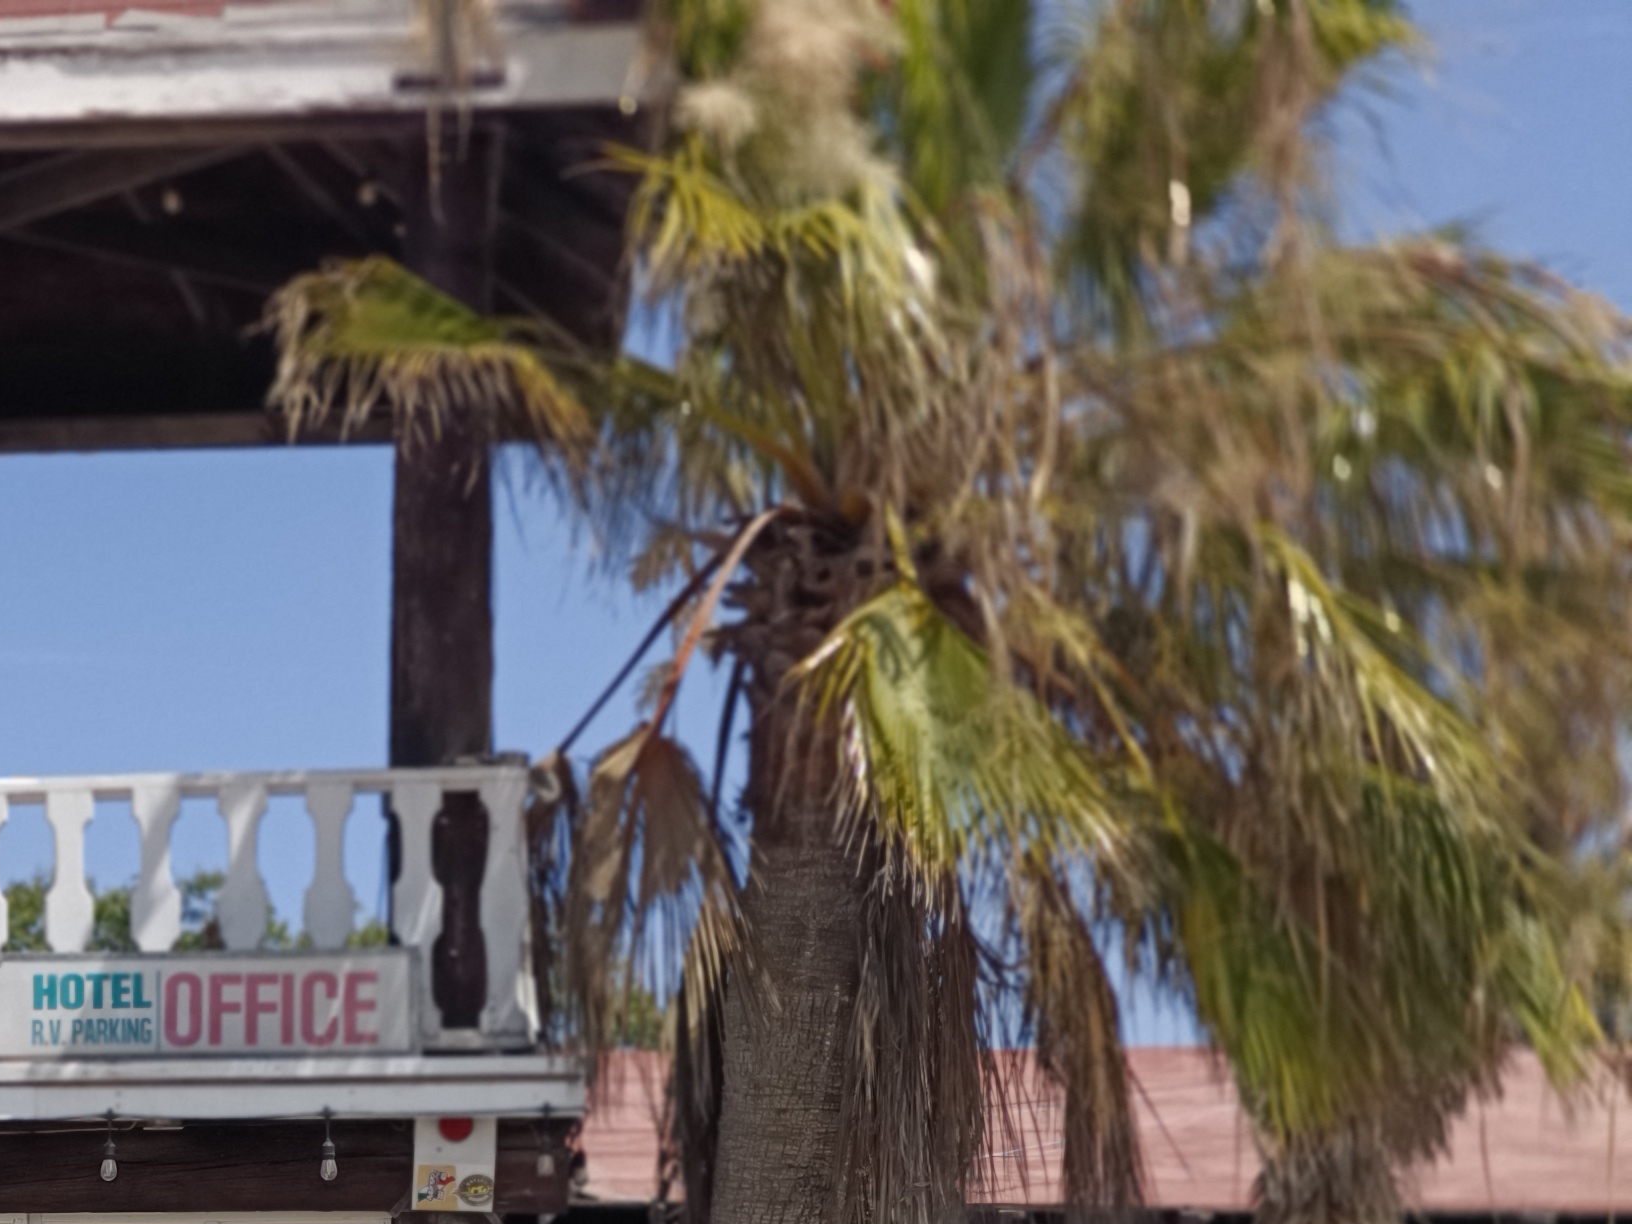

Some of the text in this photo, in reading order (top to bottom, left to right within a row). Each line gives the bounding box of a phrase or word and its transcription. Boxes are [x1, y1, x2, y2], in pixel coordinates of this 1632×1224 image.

[32, 971, 152, 1010] HOTEL
[164, 971, 380, 1048] OFFICE
[71, 1017, 153, 1045] PARKING
